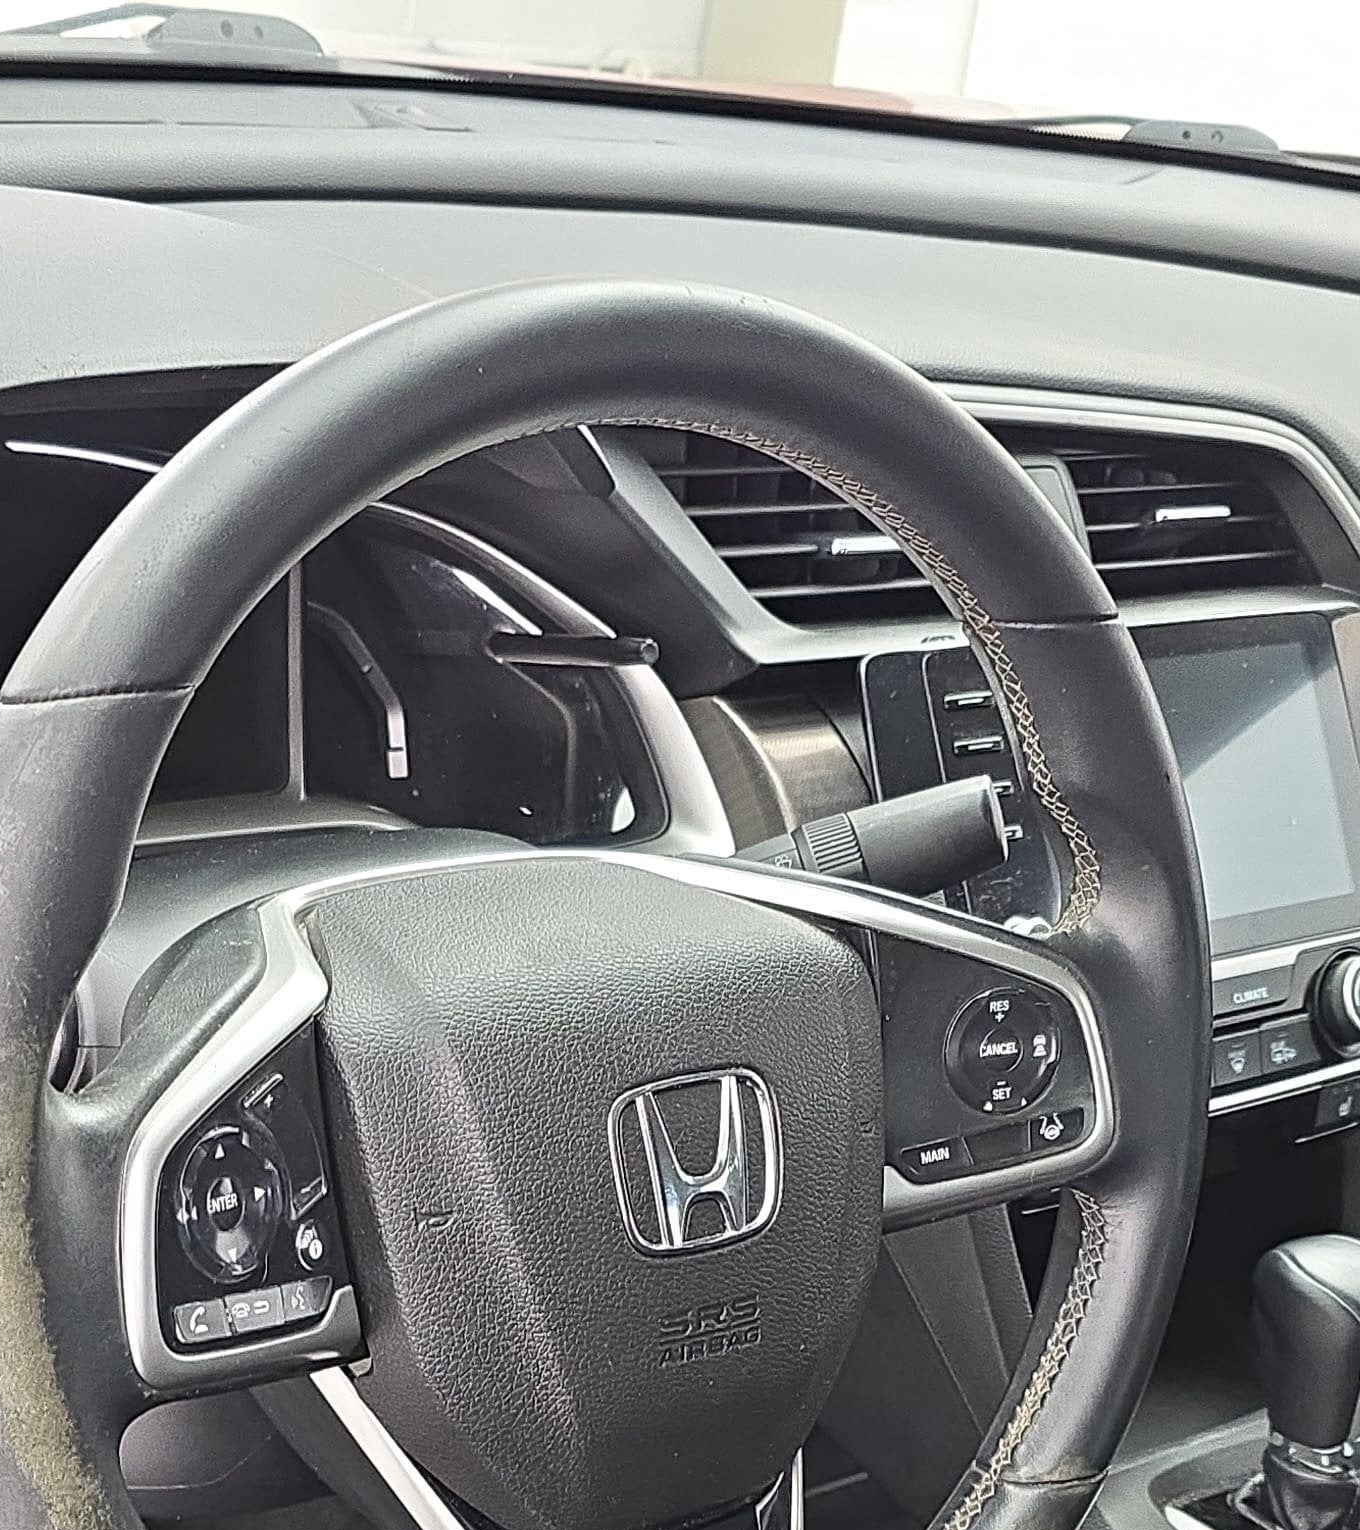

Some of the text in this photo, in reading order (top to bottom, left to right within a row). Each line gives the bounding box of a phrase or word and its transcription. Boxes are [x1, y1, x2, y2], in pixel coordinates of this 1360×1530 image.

[989, 1000, 1010, 1012] RES
[980, 1041, 1018, 1057] CANCEL
[992, 1086, 1011, 1100] SET
[920, 1147, 951, 1165] MAIN
[207, 1194, 239, 1212] ENTER
[659, 1297, 762, 1338] SRS
[658, 1326, 762, 1368] AIRBAG
